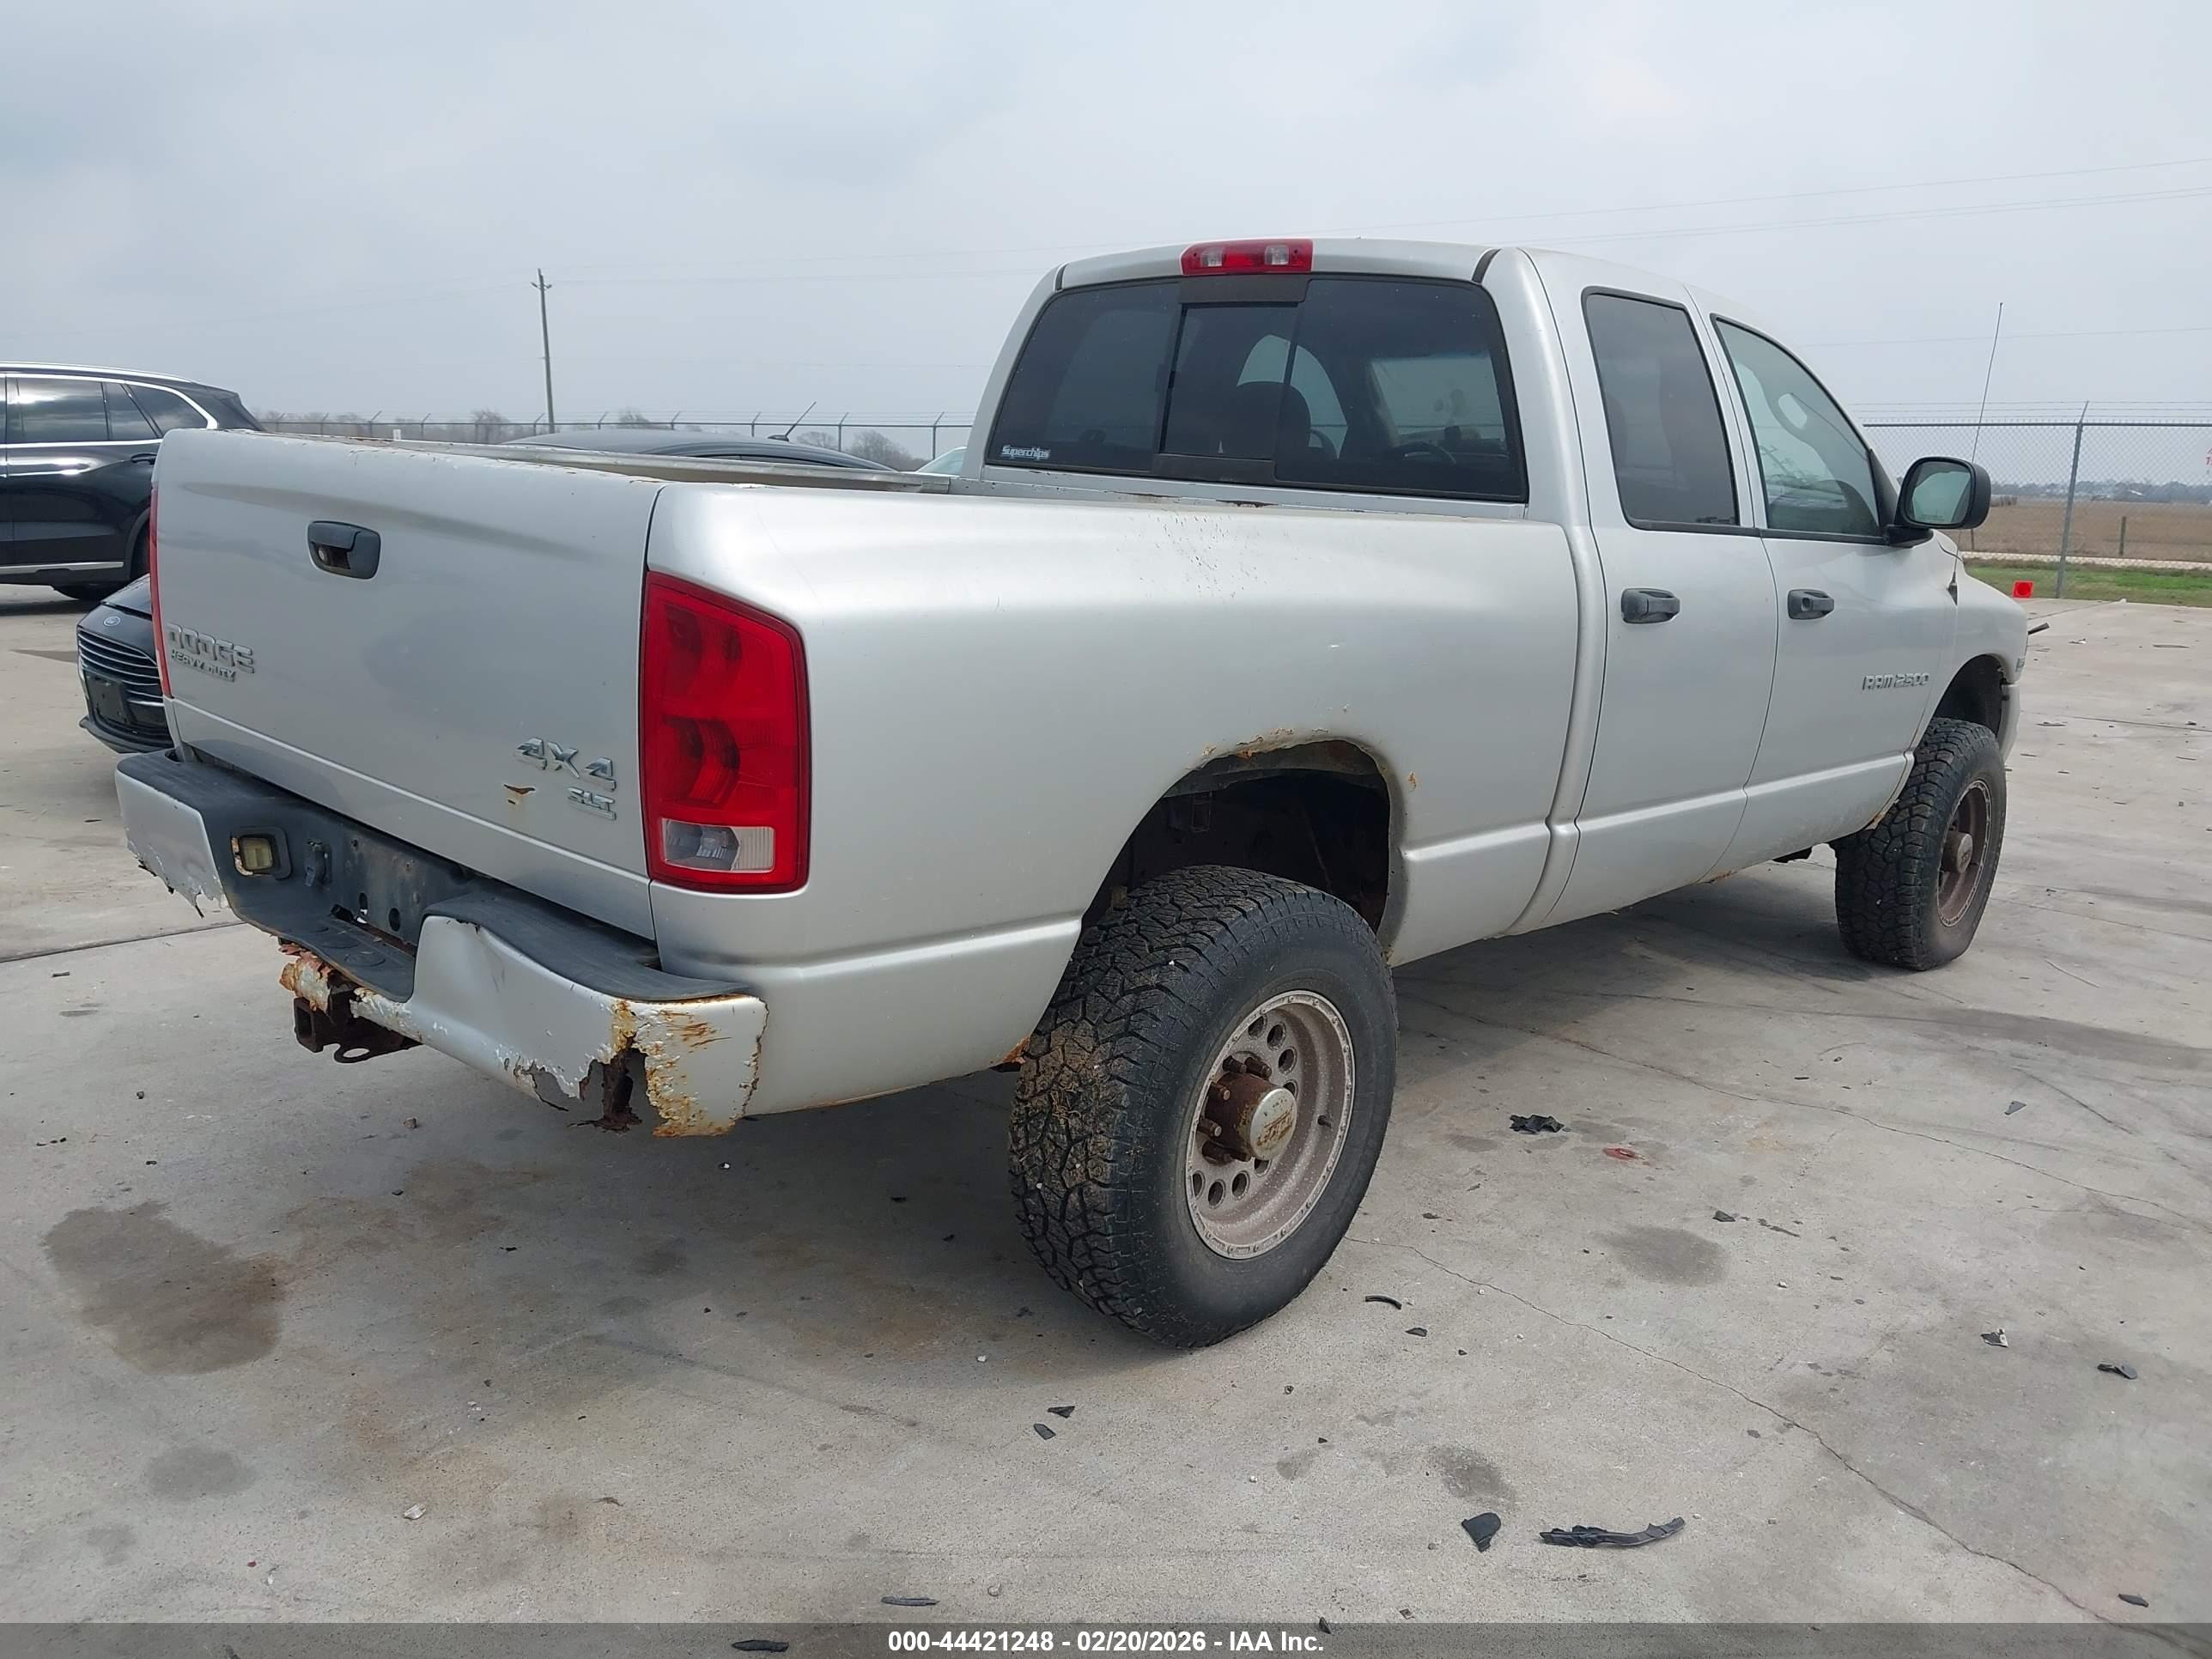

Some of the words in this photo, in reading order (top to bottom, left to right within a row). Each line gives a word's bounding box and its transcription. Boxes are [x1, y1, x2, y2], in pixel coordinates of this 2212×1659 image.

[1001, 445, 1051, 460] Superchips
[167, 622, 255, 674] DODGE
[171, 648, 205, 670] HEAVY
[514, 737, 617, 793] 4X4
[567, 787, 617, 817] SLT
